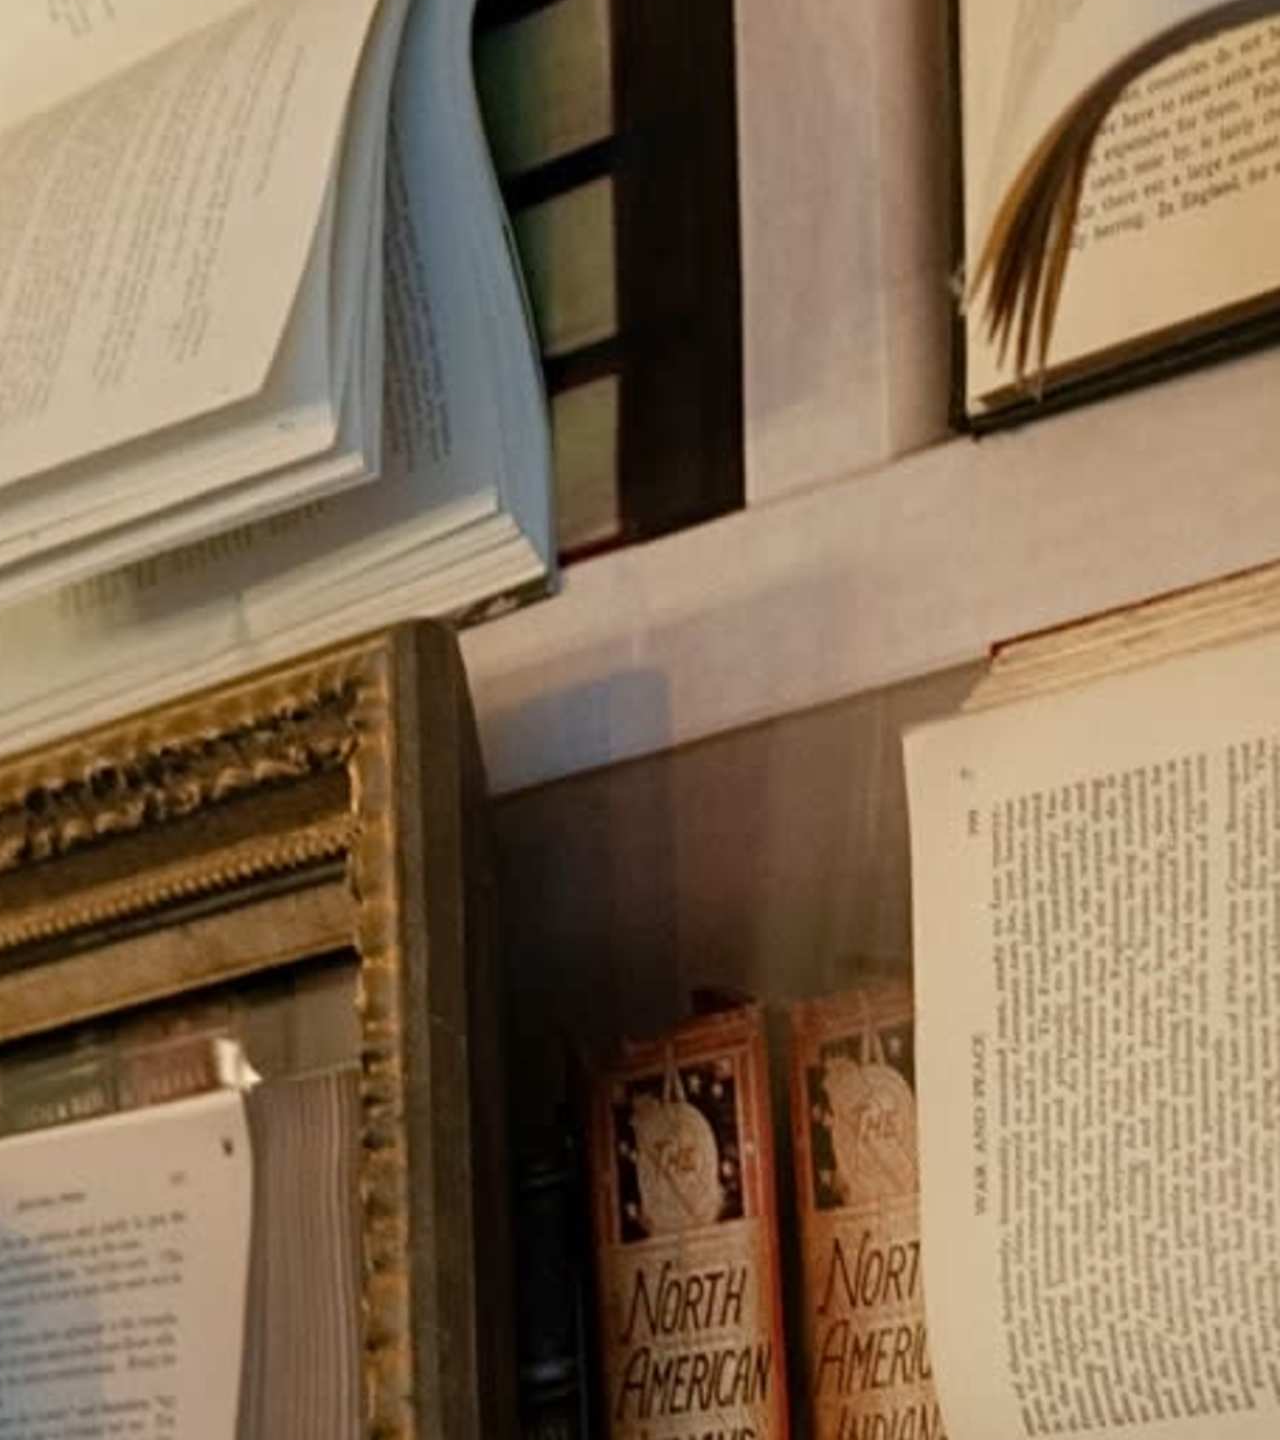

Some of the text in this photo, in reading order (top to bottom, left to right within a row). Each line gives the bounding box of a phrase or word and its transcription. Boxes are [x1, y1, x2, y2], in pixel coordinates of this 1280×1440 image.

[972, 1035, 988, 1216] WAR AND PEACE
[619, 1258, 749, 1348] NORTH
[614, 1339, 774, 1425] AMERICAN
